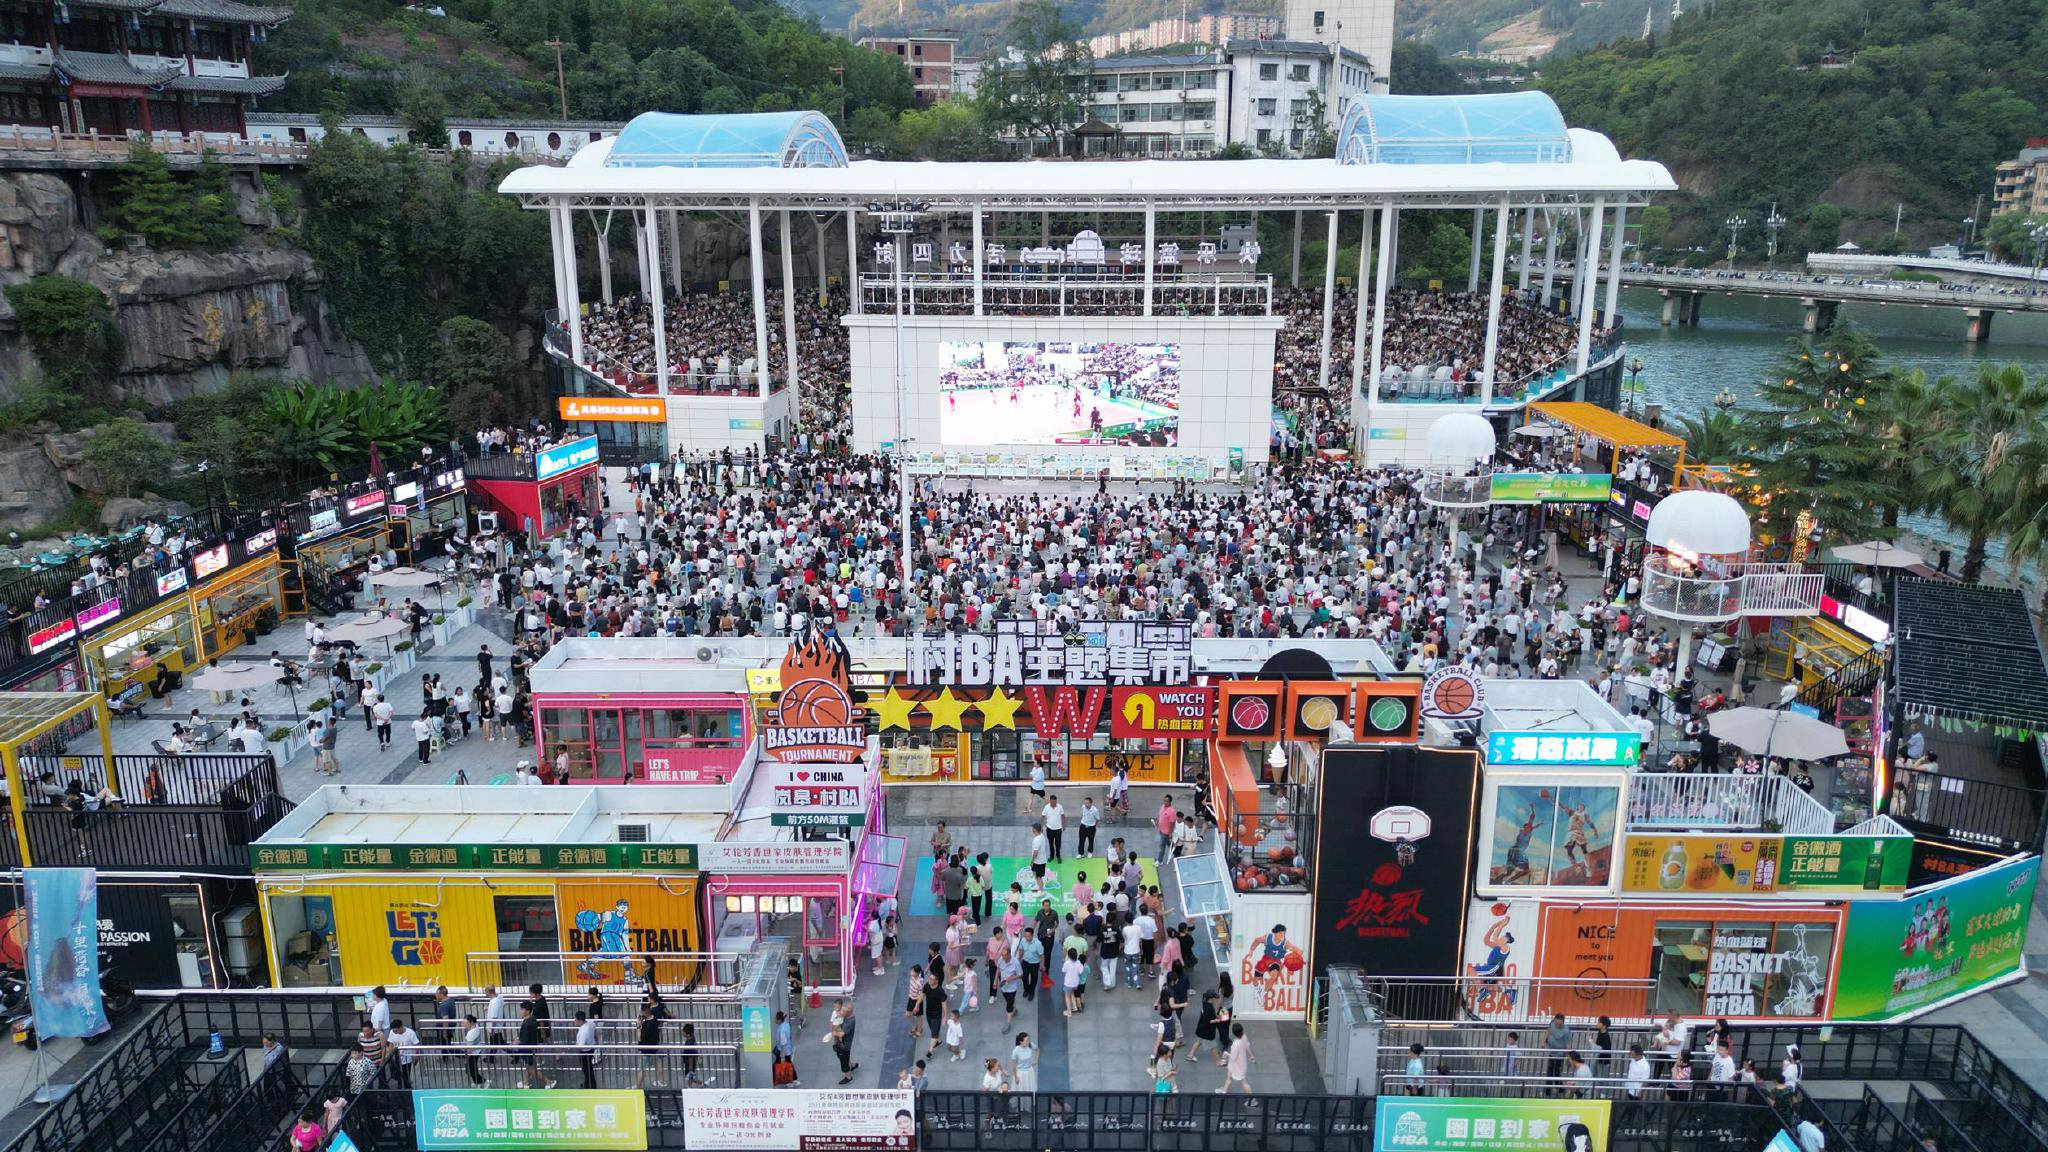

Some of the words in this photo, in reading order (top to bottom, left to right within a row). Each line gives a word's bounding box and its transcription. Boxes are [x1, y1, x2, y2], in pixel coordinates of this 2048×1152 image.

[906, 632, 1191, 686] 村BA主题集市
[1424, 667, 1473, 701] BASKETBALL
[1474, 678, 1485, 702] CLUB
[1159, 693, 1205, 704] WATCH
[1176, 706, 1205, 717] YOU
[1157, 719, 1205, 730] 热血篮球
[766, 727, 865, 748] BASKETBALL
[649, 759, 669, 769] LET'S
[779, 749, 853, 763] TOURNAMENT
[650, 770, 671, 781] HAVE
[672, 770, 678, 781] A
[680, 770, 699, 781] TRIP
[789, 772, 793, 782] I
[813, 771, 844, 782] CHINA
[775, 788, 860, 806] 岚皋·村BA
[787, 814, 849, 825] 前方50M灌篮
[258, 848, 308, 864] 金徽酒
[343, 848, 393, 864] 正能量
[409, 848, 458, 864] 金徽酒
[492, 848, 542, 864] 正能量
[558, 848, 607, 864] 金徽酒
[641, 848, 691, 864] 正能量
[1792, 841, 1842, 856] 金徽酒
[1789, 857, 1841, 873] 正能量
[1335, 889, 1430, 929] 热烈
[386, 911, 441, 938] LET'S
[1577, 926, 1616, 939] NICE
[100, 932, 151, 942] PASSION
[1714, 936, 1767, 948] 热血篮球
[1598, 954, 1614, 962] you
[1710, 952, 1785, 973] BASKET
[1708, 973, 1753, 994] BALL
[1264, 988, 1305, 1012] BALL
[1705, 995, 1755, 1015] 村BA
